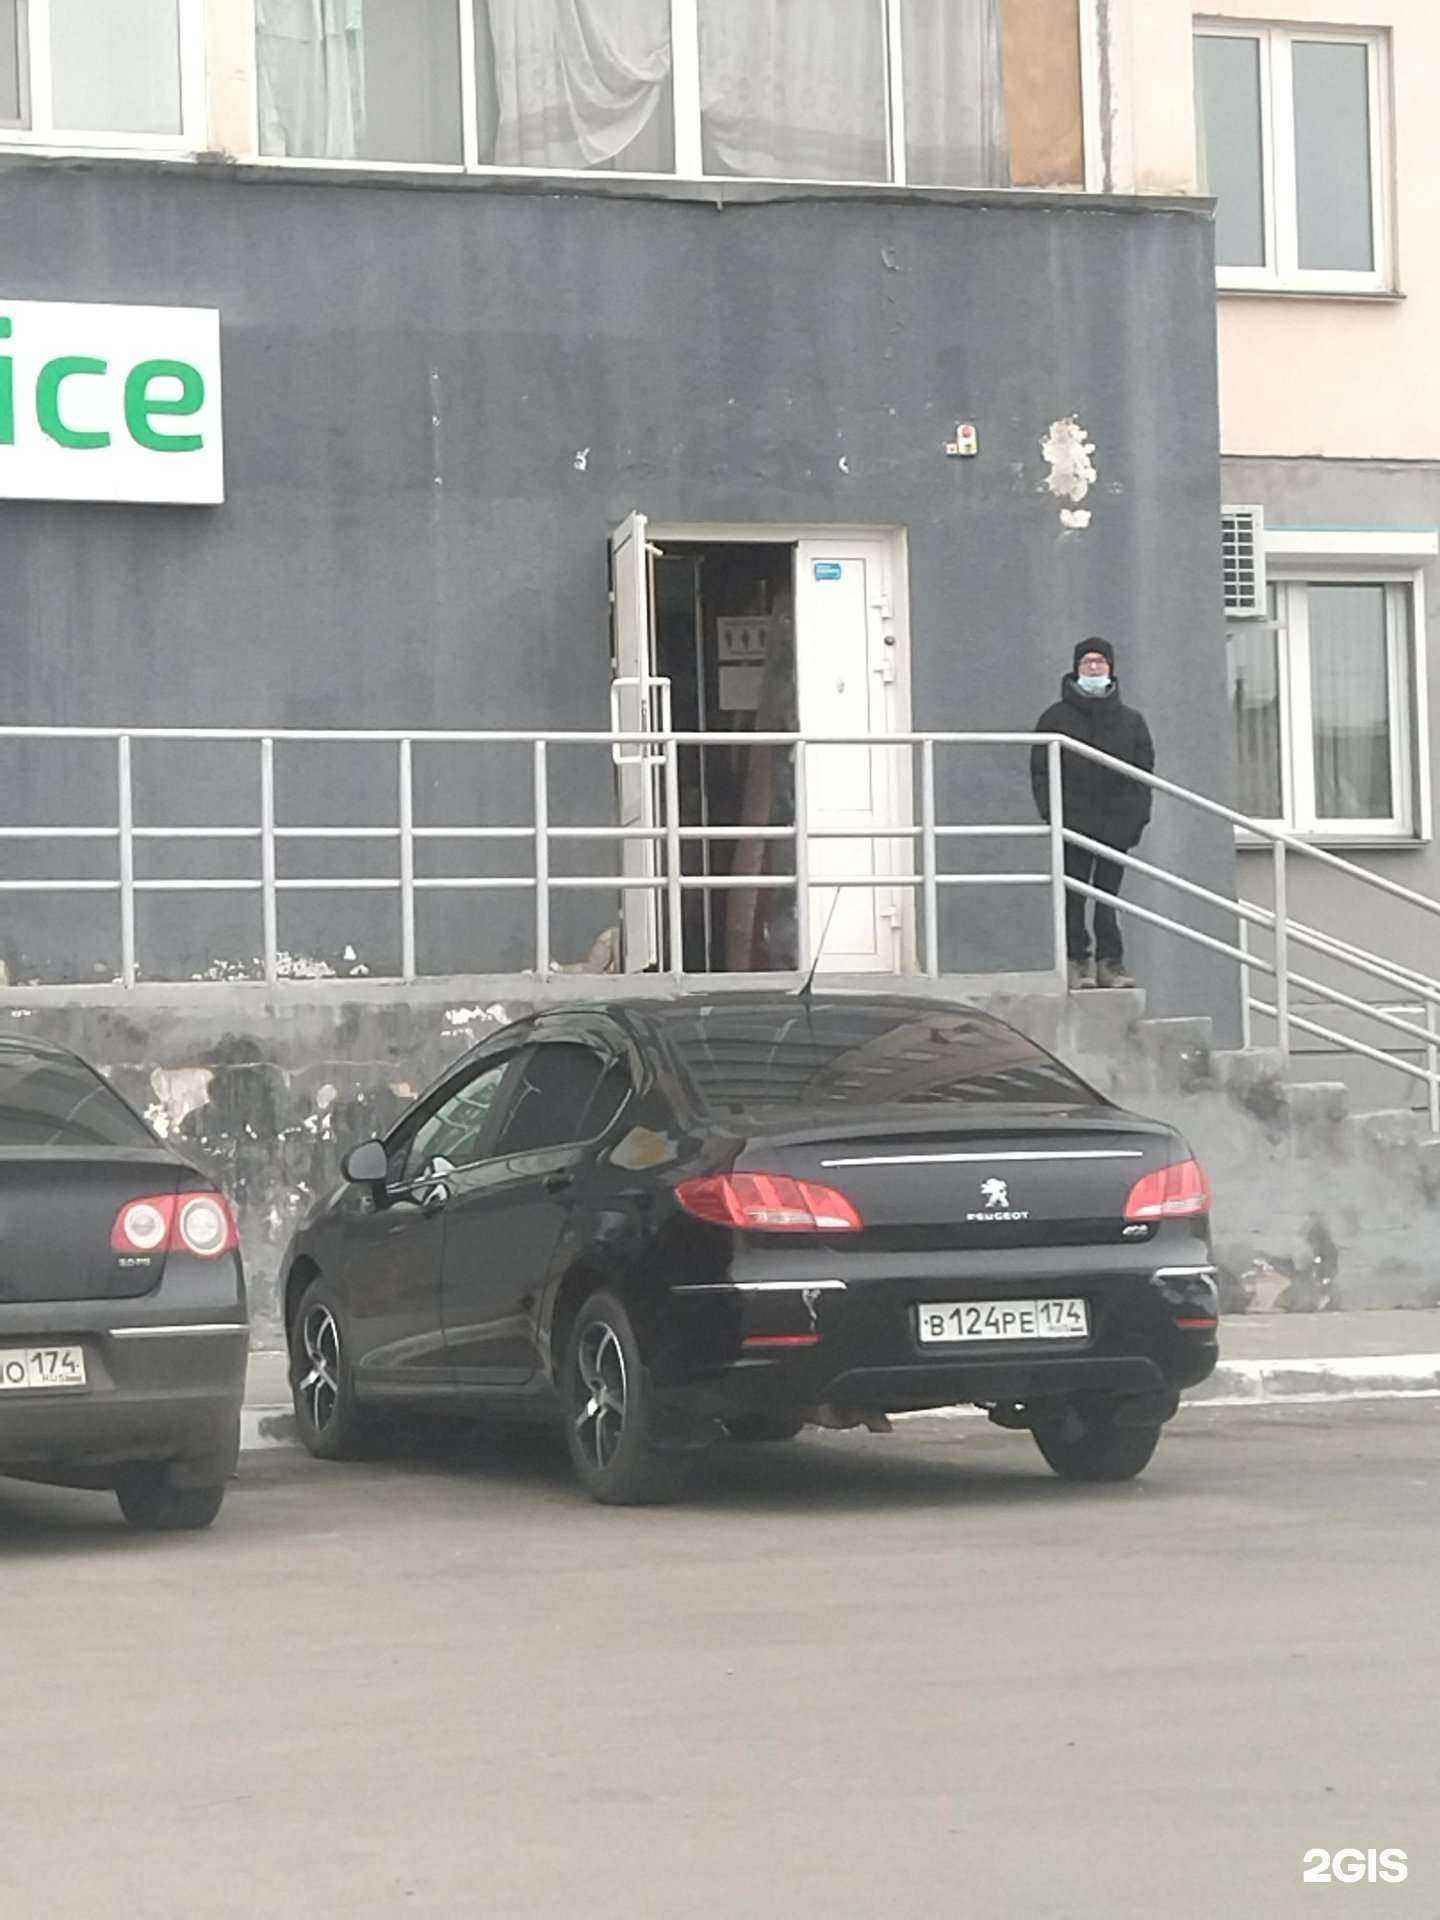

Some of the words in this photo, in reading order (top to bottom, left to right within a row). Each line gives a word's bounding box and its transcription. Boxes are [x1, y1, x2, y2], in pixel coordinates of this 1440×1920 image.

[966, 1211, 1029, 1221] PEUGEOT
[1040, 1302, 1081, 1324] 174
[30, 1350, 76, 1374] 174
